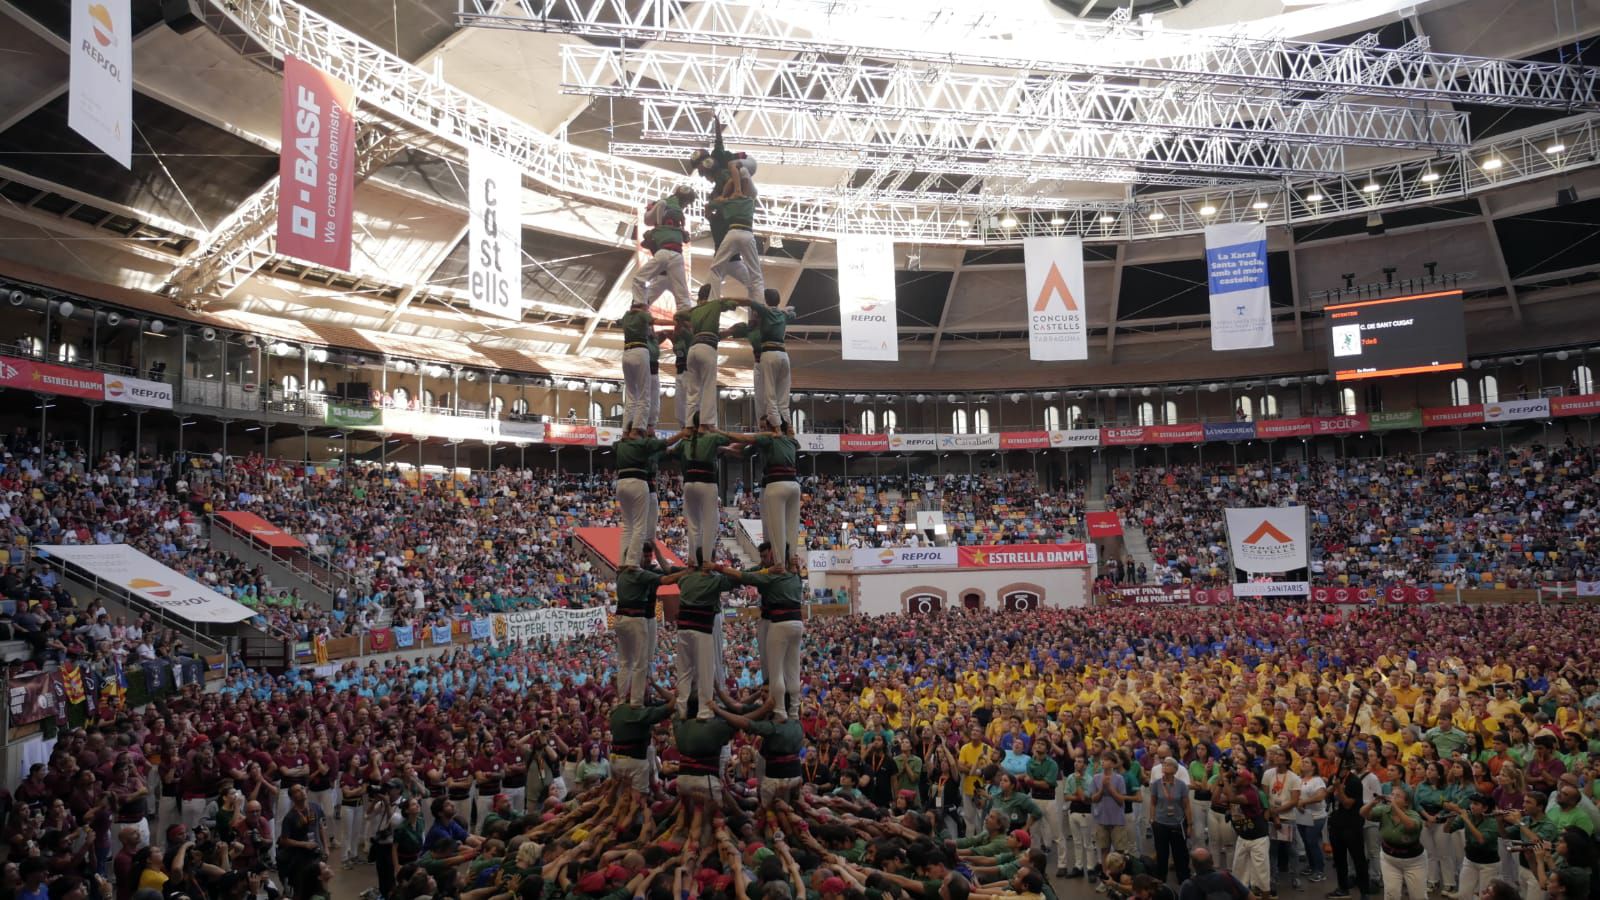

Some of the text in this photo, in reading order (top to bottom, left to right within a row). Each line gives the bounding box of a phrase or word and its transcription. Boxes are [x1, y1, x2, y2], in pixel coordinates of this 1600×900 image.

[81, 39, 121, 82] REPSOL
[295, 85, 321, 187] BASF
[324, 99, 342, 243] We create chemistry
[1231, 251, 1257, 259] Xarxa
[1211, 261, 1236, 269] Santa
[1211, 269, 1231, 277] amb
[1232, 268, 1241, 276] el
[1219, 275, 1259, 285] casteller
[851, 314, 887, 322] REPSOL
[1033, 314, 1080, 323] CONCURS
[1033, 322, 1080, 331] CASTELLS
[42, 375, 103, 391] ESTRELLA DAMM
[131, 387, 171, 401] REPSOL
[348, 408, 375, 419] BASF
[1508, 405, 1548, 414] REPSOL
[1319, 418, 1353, 430] 3cat
[1120, 428, 1144, 437] BASF
[902, 552, 944, 561] REPSOL
[989, 552, 1047, 564] ESTRELLA
[1047, 550, 1084, 562] DAMM
[1267, 584, 1304, 592] SANITARIS
[160, 596, 211, 607] EPSOL
[509, 612, 540, 624] COLLA
[510, 625, 523, 637] ST.
[525, 622, 546, 635] PERE
[553, 620, 566, 632] ST.
[568, 620, 585, 631] PAU
